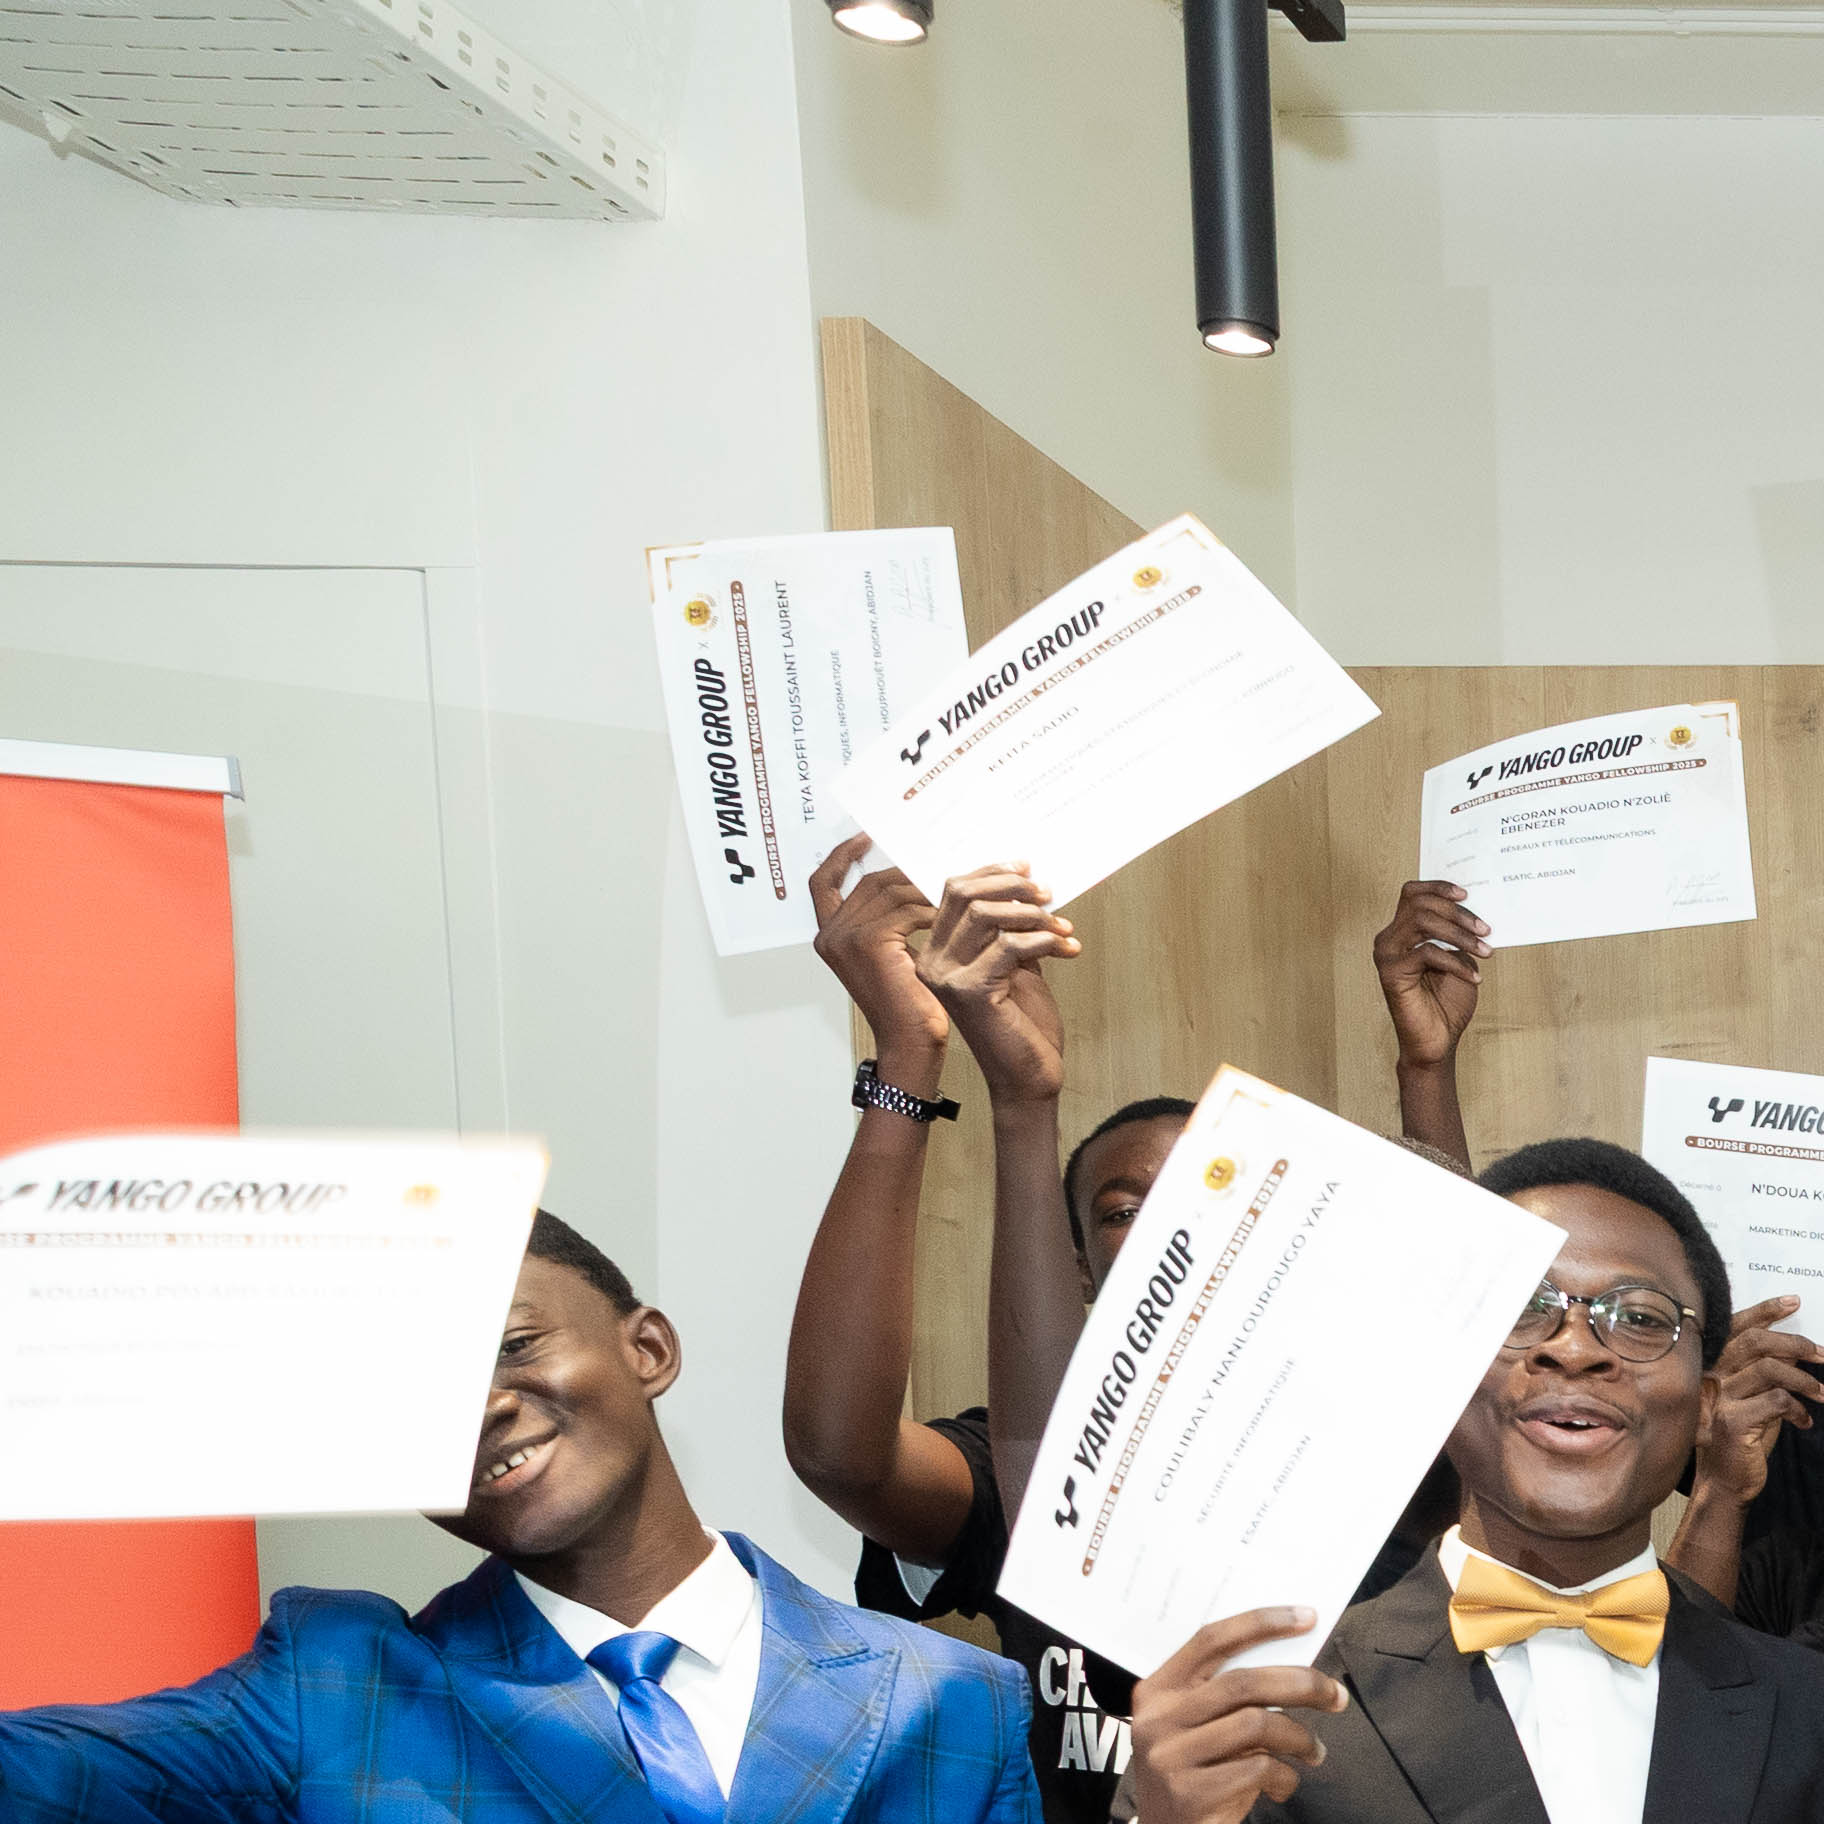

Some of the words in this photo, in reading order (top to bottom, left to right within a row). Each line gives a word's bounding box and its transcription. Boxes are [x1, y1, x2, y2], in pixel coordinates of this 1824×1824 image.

[731, 591, 746, 622] 2025
[774, 580, 793, 648] LAURENT
[863, 570, 876, 615] ABIDJAN
[735, 623, 757, 703] FELLOWSHIP
[937, 661, 1018, 735] YANGO
[1021, 600, 1104, 671] GROUP
[693, 658, 733, 747] GROUP
[783, 652, 803, 734] TOUSSAINT
[829, 650, 847, 727] INFORMATIQUE
[746, 705, 763, 749] YANGO
[793, 738, 809, 781] KOFFI
[1497, 746, 1566, 780] YANGO
[1568, 734, 1642, 764] GROUP
[706, 751, 748, 837] YANGO
[752, 751, 775, 834] PROGRAMME
[800, 784, 815, 823] TEYA
[1560, 799, 1620, 820] KOUADIO
[1500, 817, 1565, 835] EBENEZER
[764, 835, 785, 888] BOURSE
[1696, 1137, 1746, 1152] BOURSE
[1751, 1183, 1808, 1199] N'DOUA
[1748, 1225, 1807, 1238] MARKETING
[1073, 1350, 1136, 1474] YANGO
[1125, 1228, 1194, 1354] GROUP
[1154, 1389, 1213, 1502] COULIBALY
[1302, 1182, 1339, 1227] YAYA
